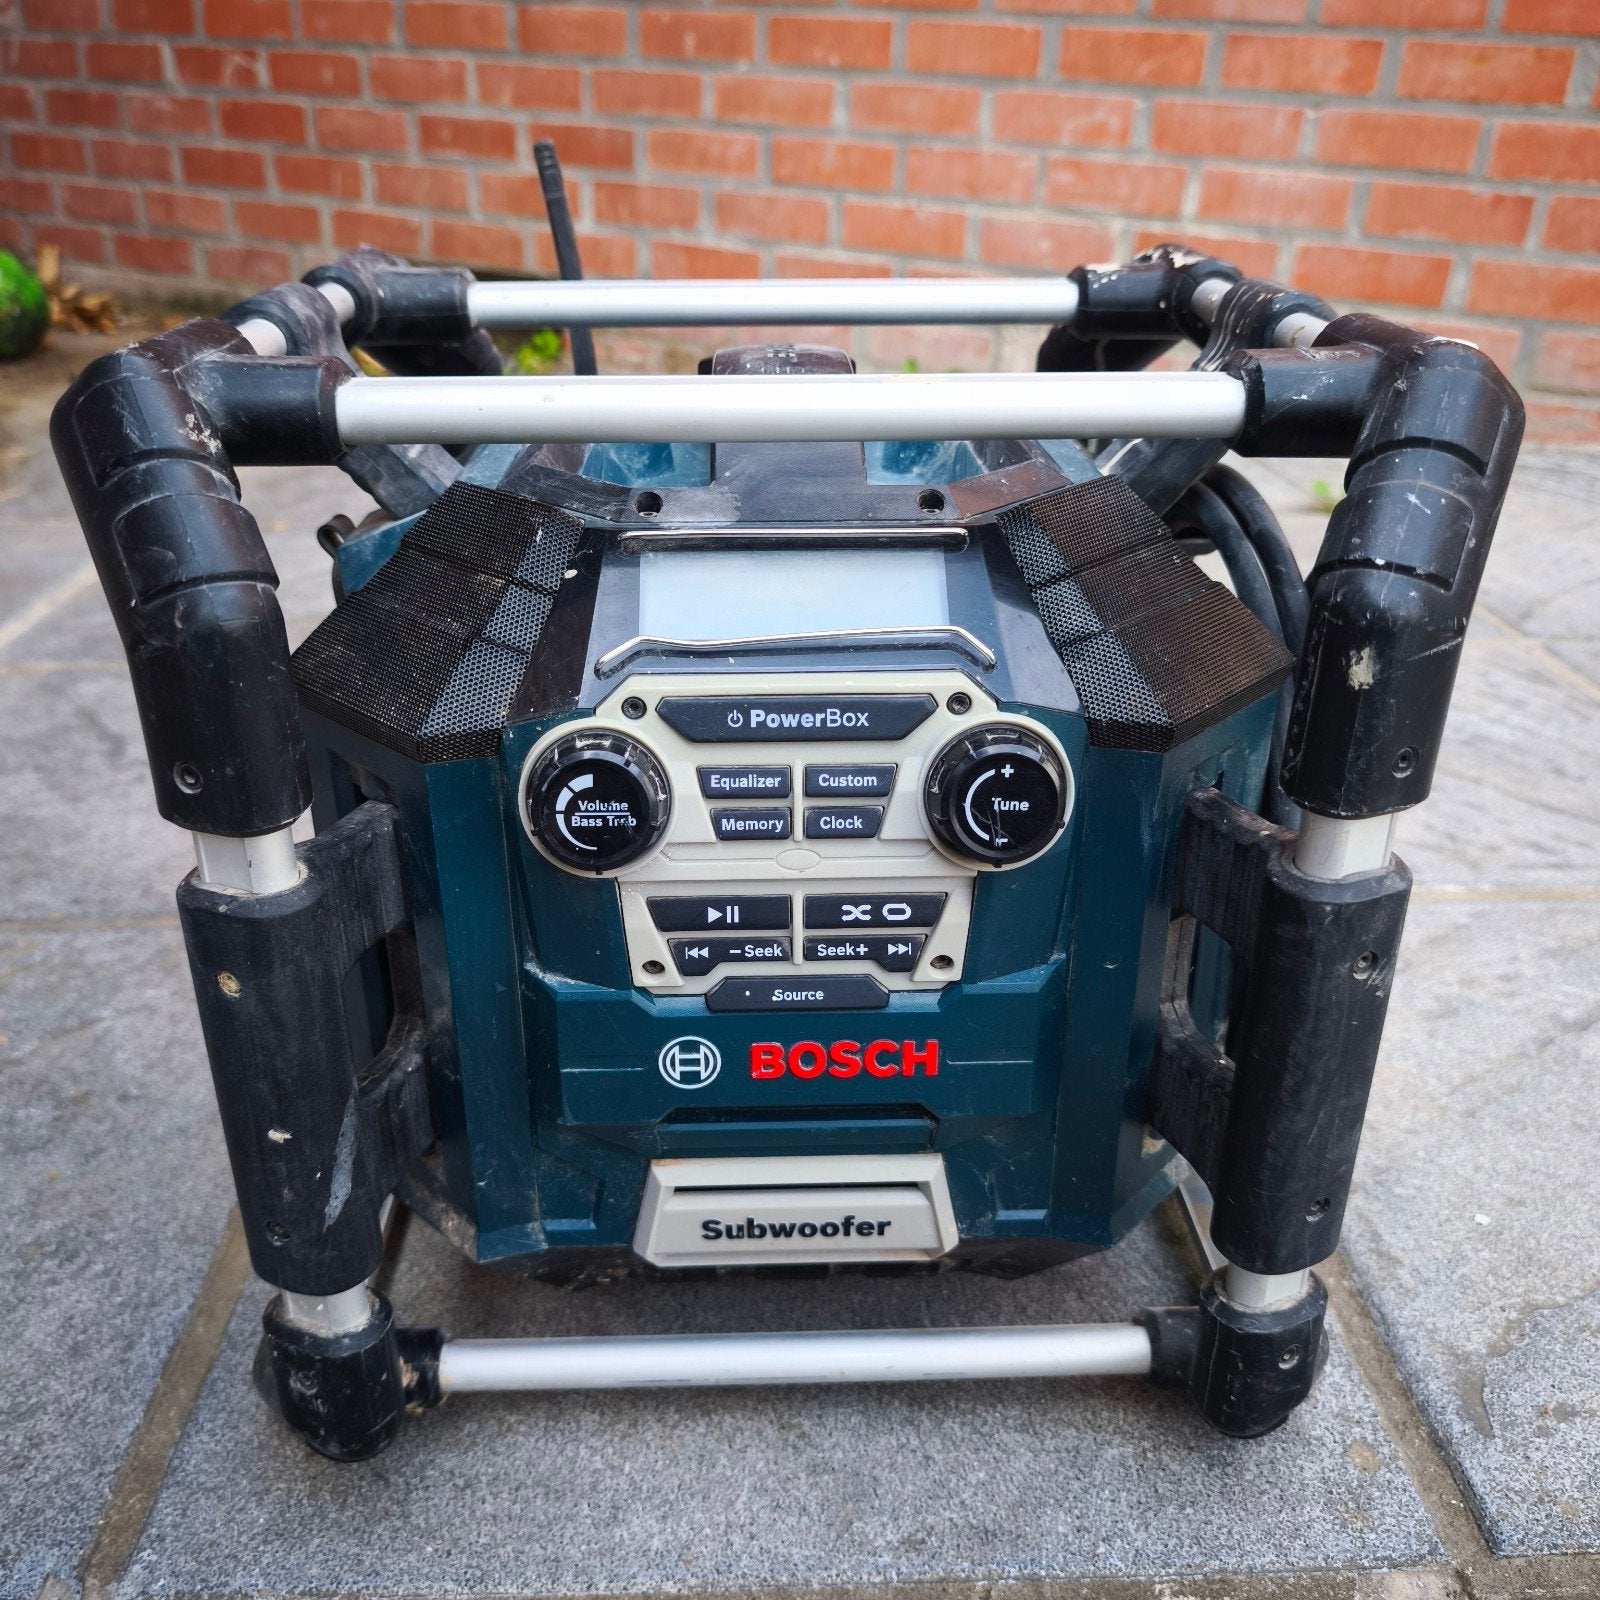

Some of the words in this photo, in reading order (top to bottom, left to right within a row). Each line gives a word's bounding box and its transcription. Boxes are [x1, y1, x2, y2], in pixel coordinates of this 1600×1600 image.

[750, 708, 870, 728] PowerBox
[710, 774, 782, 790] Equalizer
[818, 773, 878, 787] Custom
[577, 799, 629, 812] Volume
[991, 797, 1030, 812] Tune
[571, 815, 603, 827] Bass
[721, 818, 784, 833] Memory
[819, 815, 863, 830] Clock
[772, 988, 825, 1001] Source
[750, 1039, 940, 1080] BOSCH
[701, 1214, 893, 1241] Subwoofer
